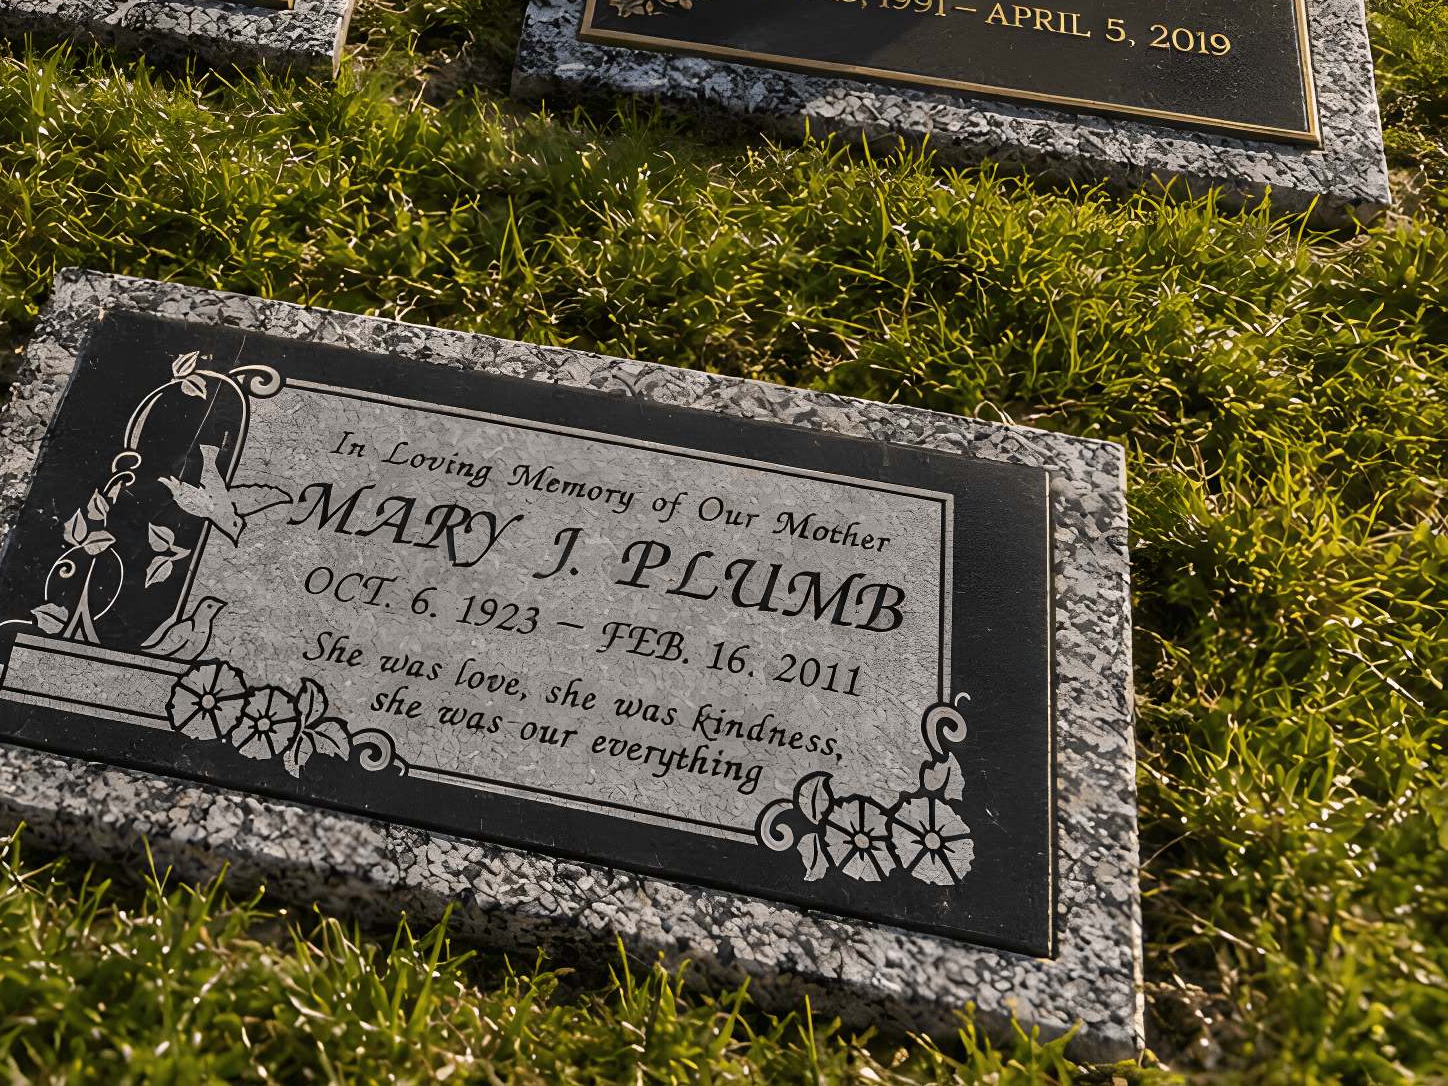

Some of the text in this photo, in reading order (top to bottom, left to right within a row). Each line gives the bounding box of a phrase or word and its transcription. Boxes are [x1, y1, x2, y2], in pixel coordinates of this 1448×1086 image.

[985, 3, 1092, 38] APRIL
[1105, 18, 1136, 48] 5,
[1150, 24, 1232, 56] 2019
[330, 431, 892, 554] In Loving Memory of Our Mother
[288, 482, 908, 635] MARY J. PLUMB
[304, 566, 399, 608] OCT.
[411, 587, 438, 618] 6.
[455, 595, 540, 635] 1923
[596, 622, 689, 664] FEB.
[773, 653, 861, 697] 2011
[302, 631, 845, 763] She was love, she was kindness,
[370, 685, 764, 795] she was our everything
